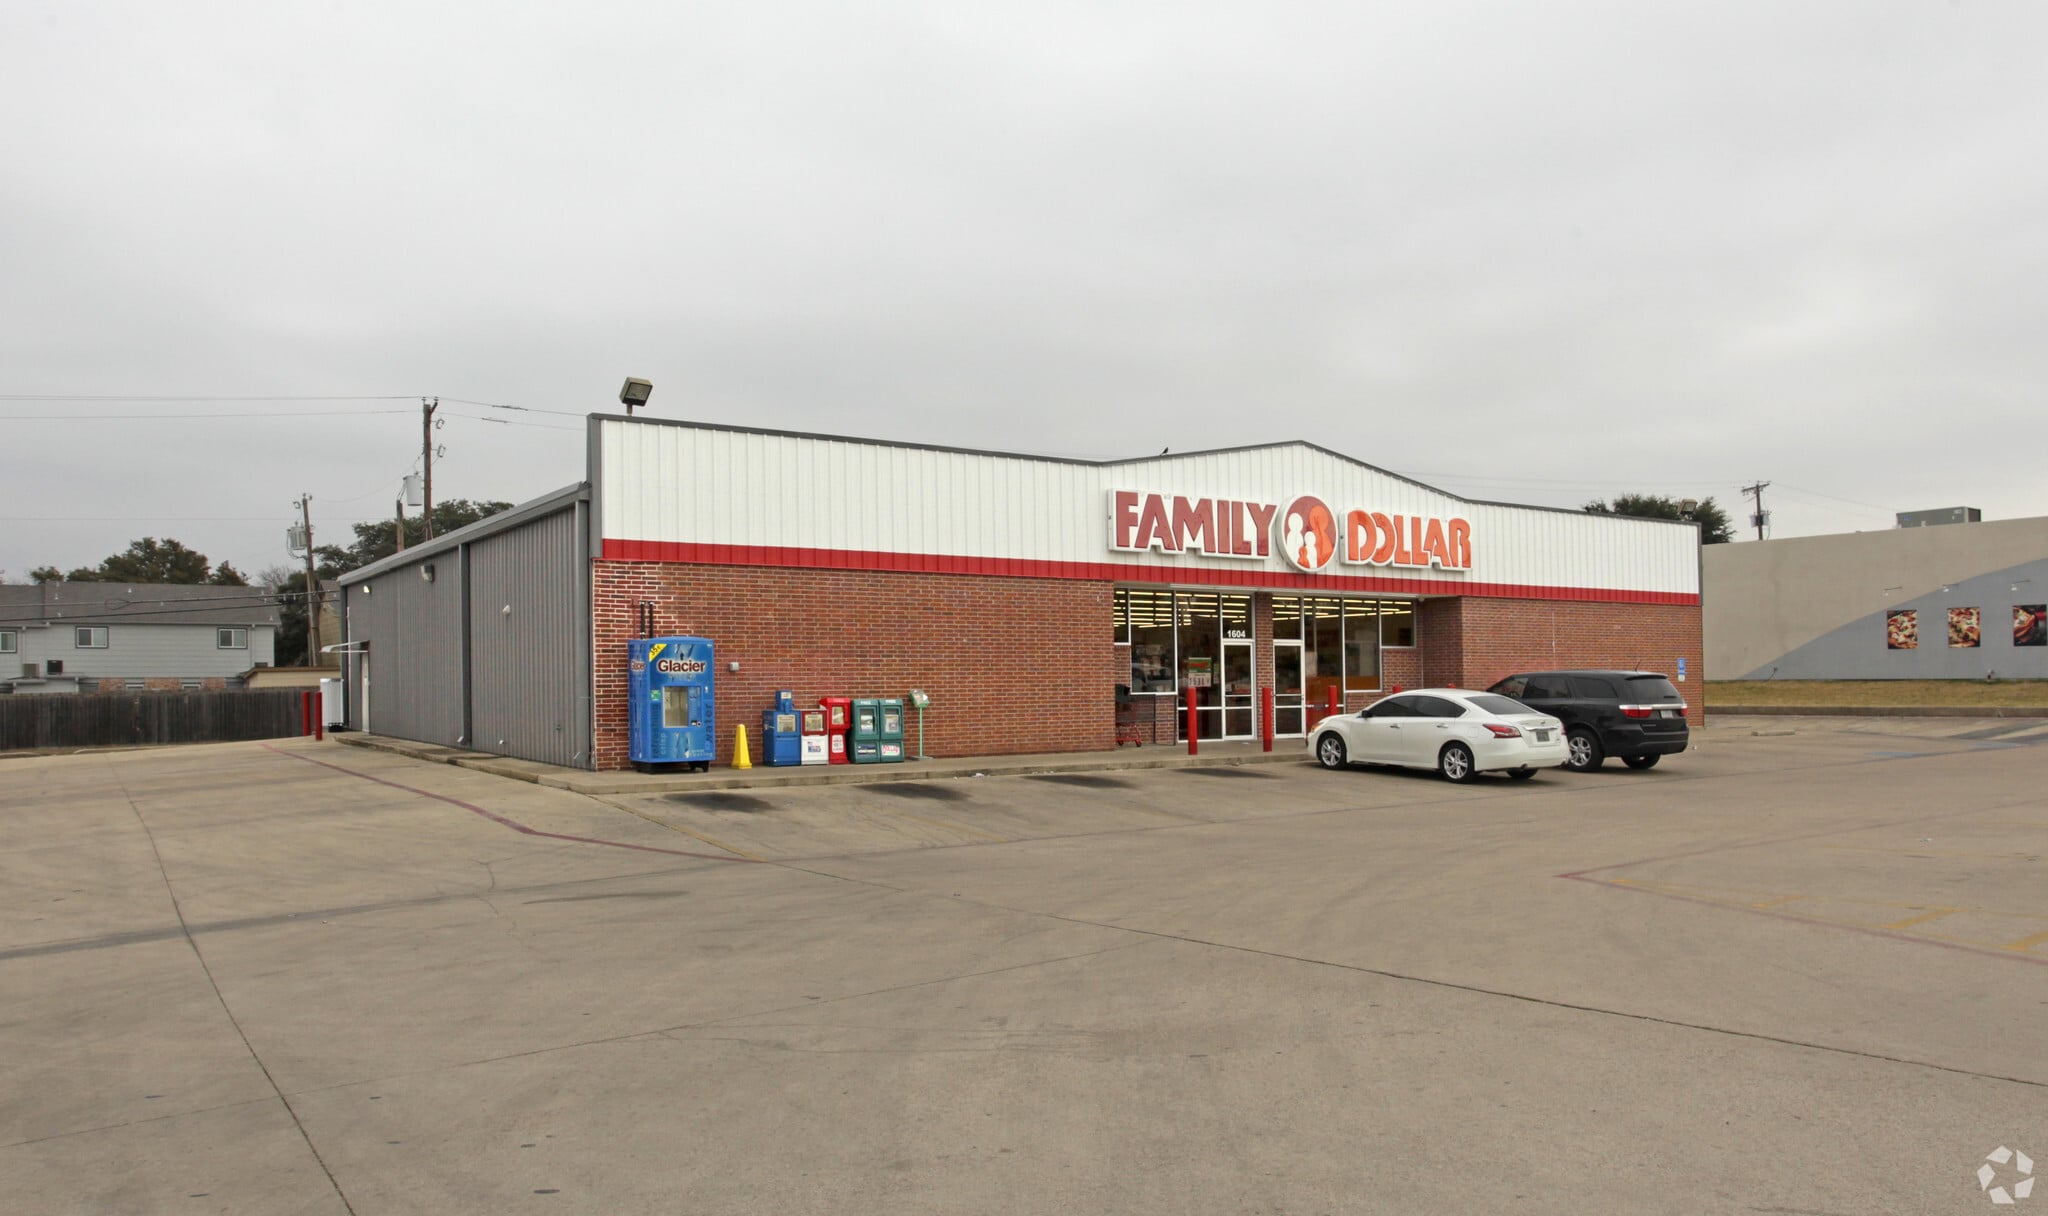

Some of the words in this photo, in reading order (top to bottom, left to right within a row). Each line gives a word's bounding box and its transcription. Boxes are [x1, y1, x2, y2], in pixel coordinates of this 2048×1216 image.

[1116, 490, 1277, 557] FAMILY
[1347, 509, 1472, 568] DOLLAR
[1227, 629, 1246, 638] 1604
[657, 659, 706, 672] Glacier
